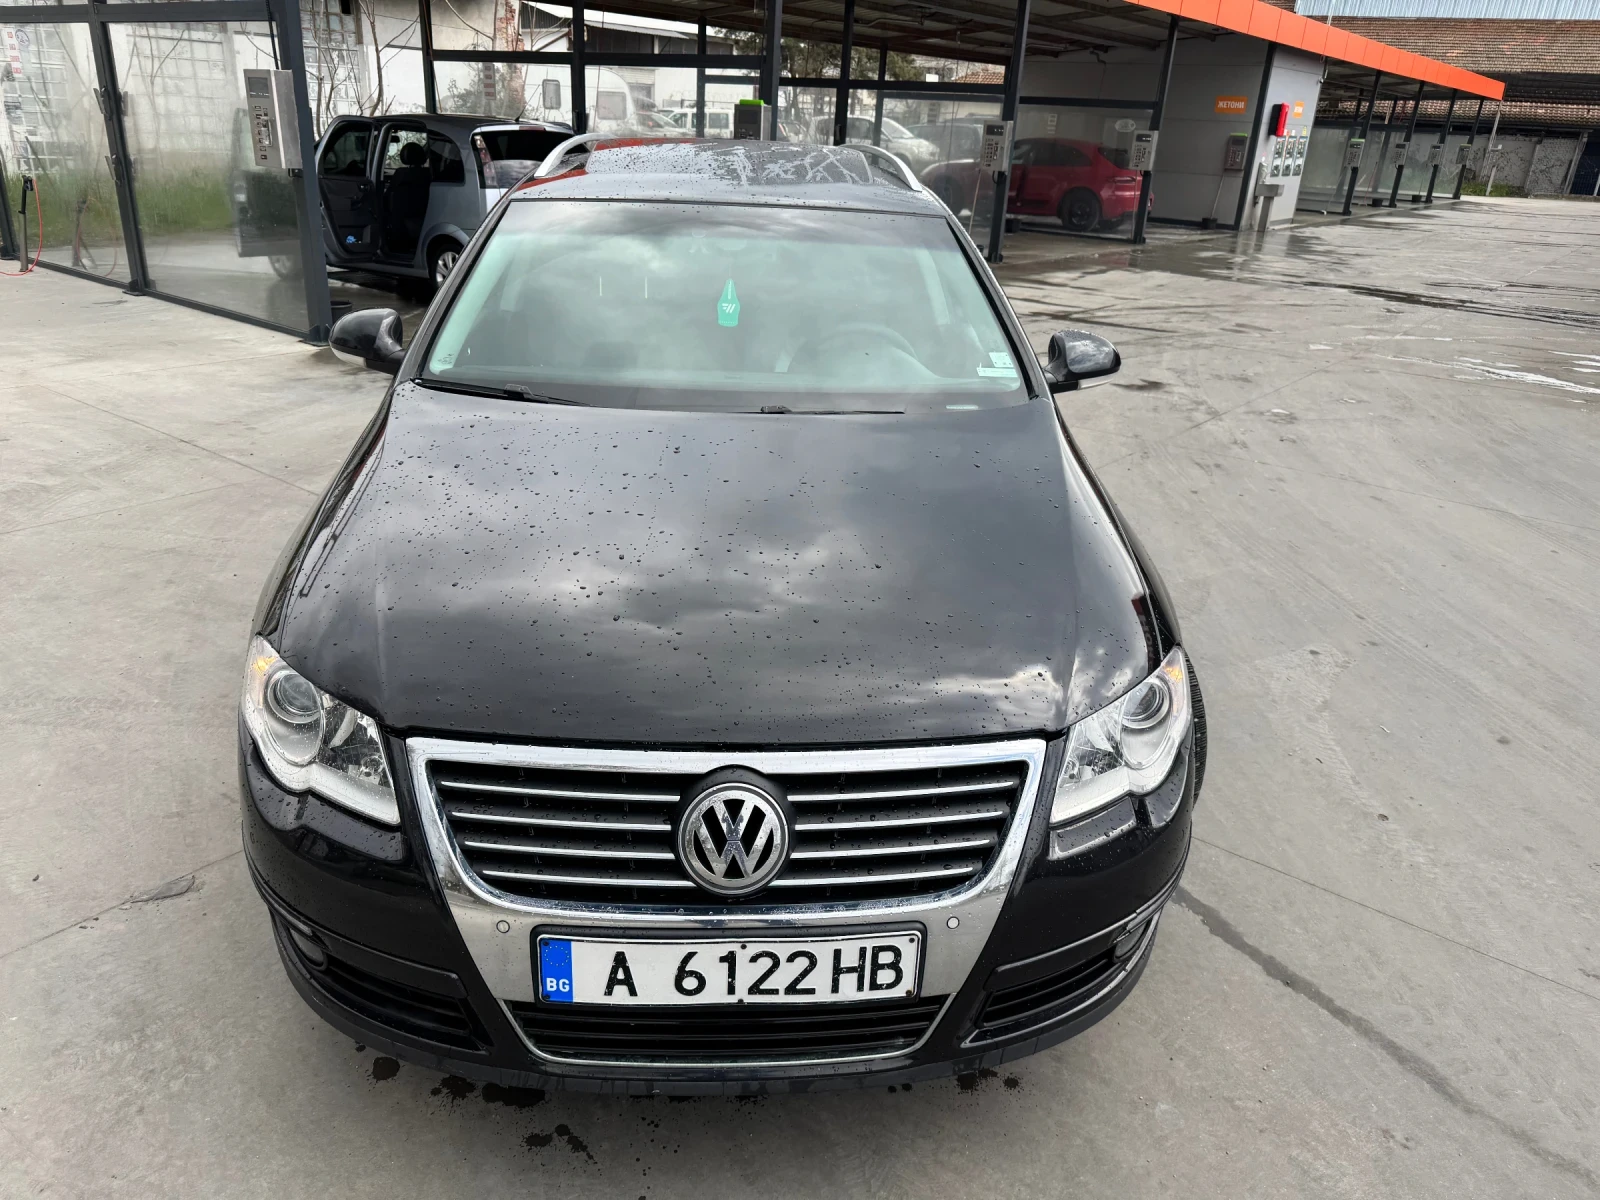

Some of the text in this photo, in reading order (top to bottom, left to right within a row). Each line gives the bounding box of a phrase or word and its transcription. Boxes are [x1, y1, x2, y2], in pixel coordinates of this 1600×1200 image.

[1217, 100, 1245, 109] ЖЕТОНИ
[687, 791, 779, 887] VW
[546, 977, 570, 992] BG
